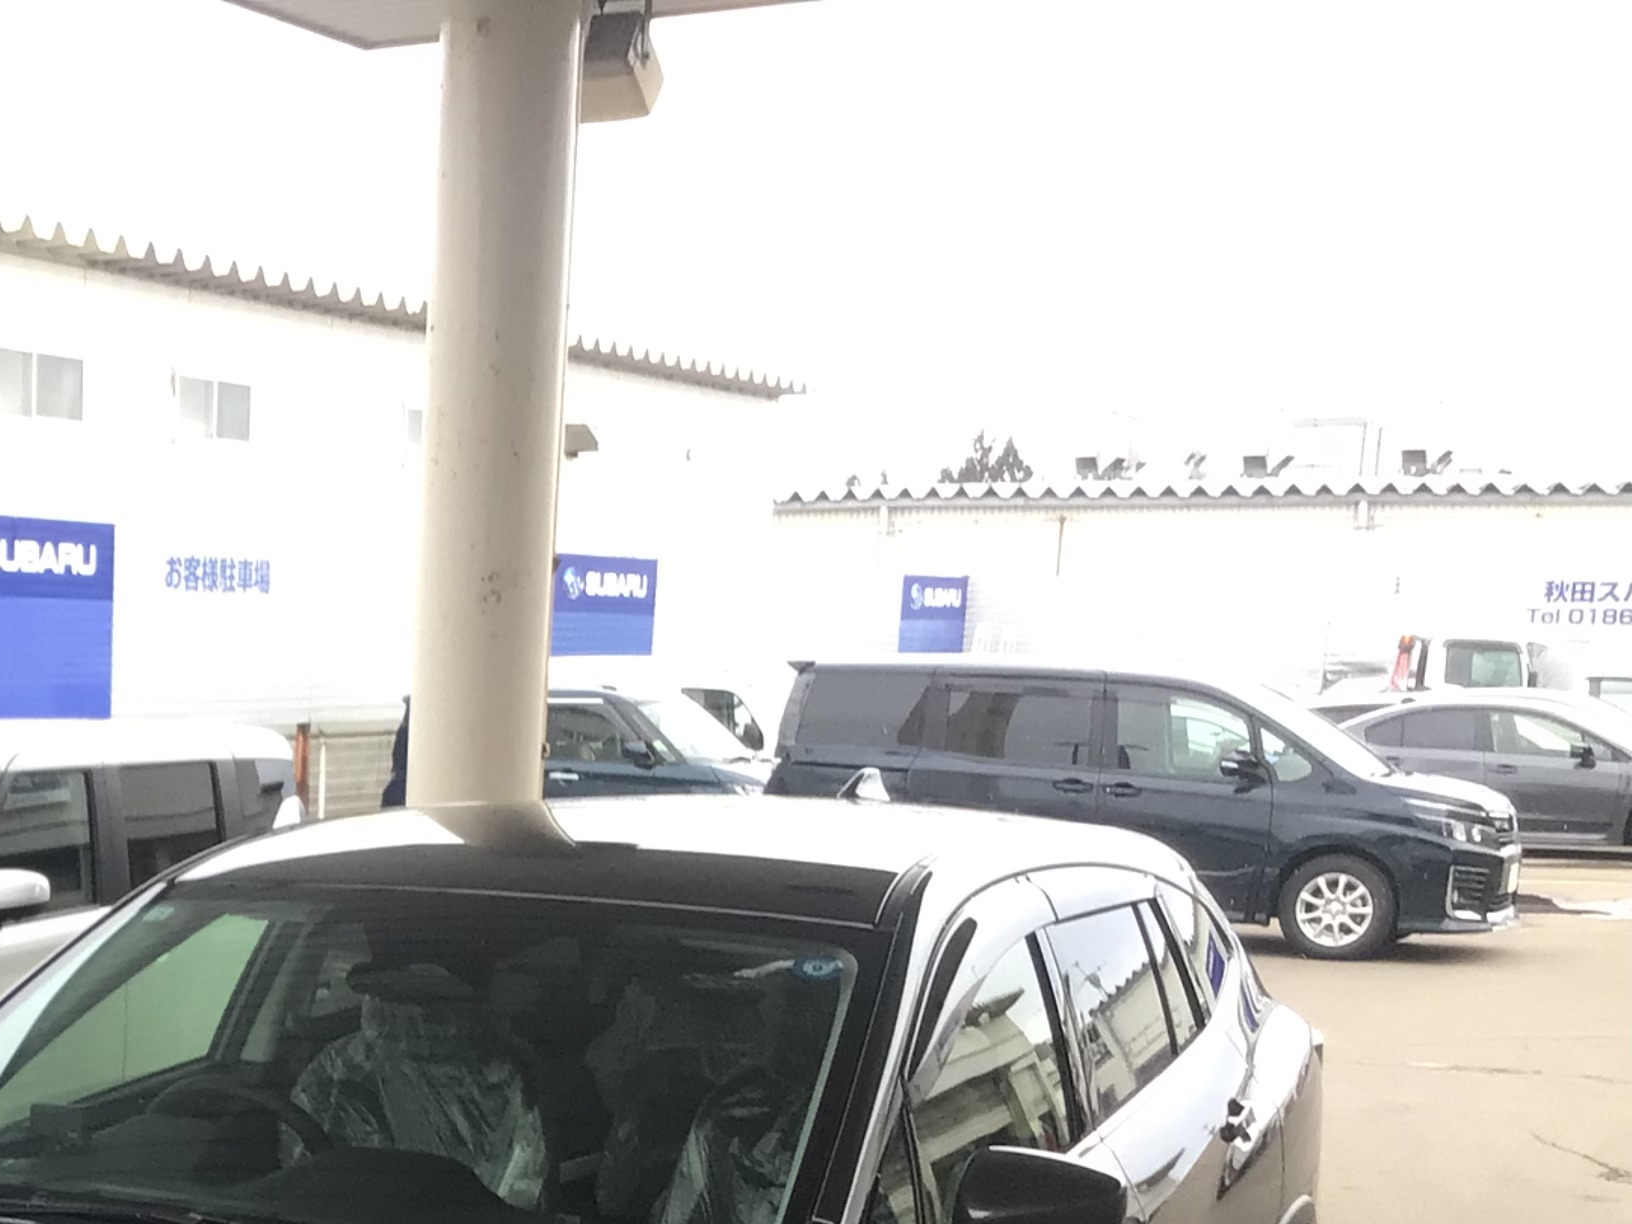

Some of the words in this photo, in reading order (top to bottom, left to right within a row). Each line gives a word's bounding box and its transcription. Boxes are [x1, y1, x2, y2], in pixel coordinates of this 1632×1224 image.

[165, 555, 272, 595] お客様駐車場
[585, 570, 648, 599] SUBARU
[923, 586, 962, 609] SUBARU
[1526, 607, 1561, 625] Tel
[1568, 607, 1632, 626] 0186
